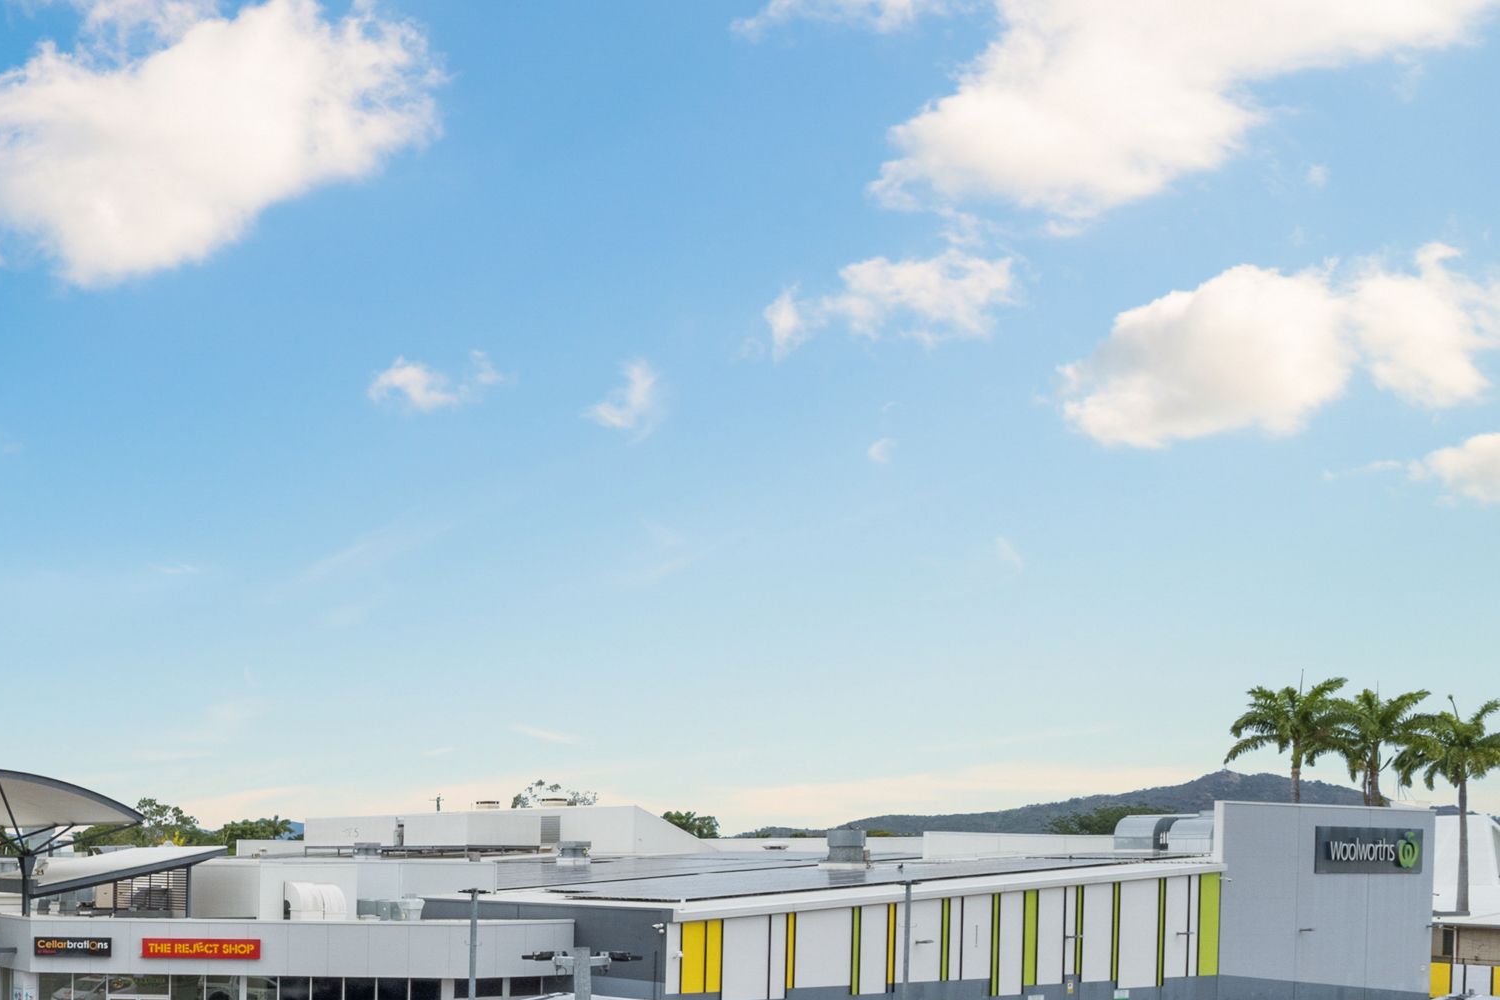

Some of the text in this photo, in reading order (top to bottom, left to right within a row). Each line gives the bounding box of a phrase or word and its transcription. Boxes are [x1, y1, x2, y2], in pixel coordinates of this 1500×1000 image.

[1330, 837, 1395, 862] Woolworths
[37, 939, 109, 950] Cellarbrations
[148, 942, 254, 954] THE REJECT SHOP
